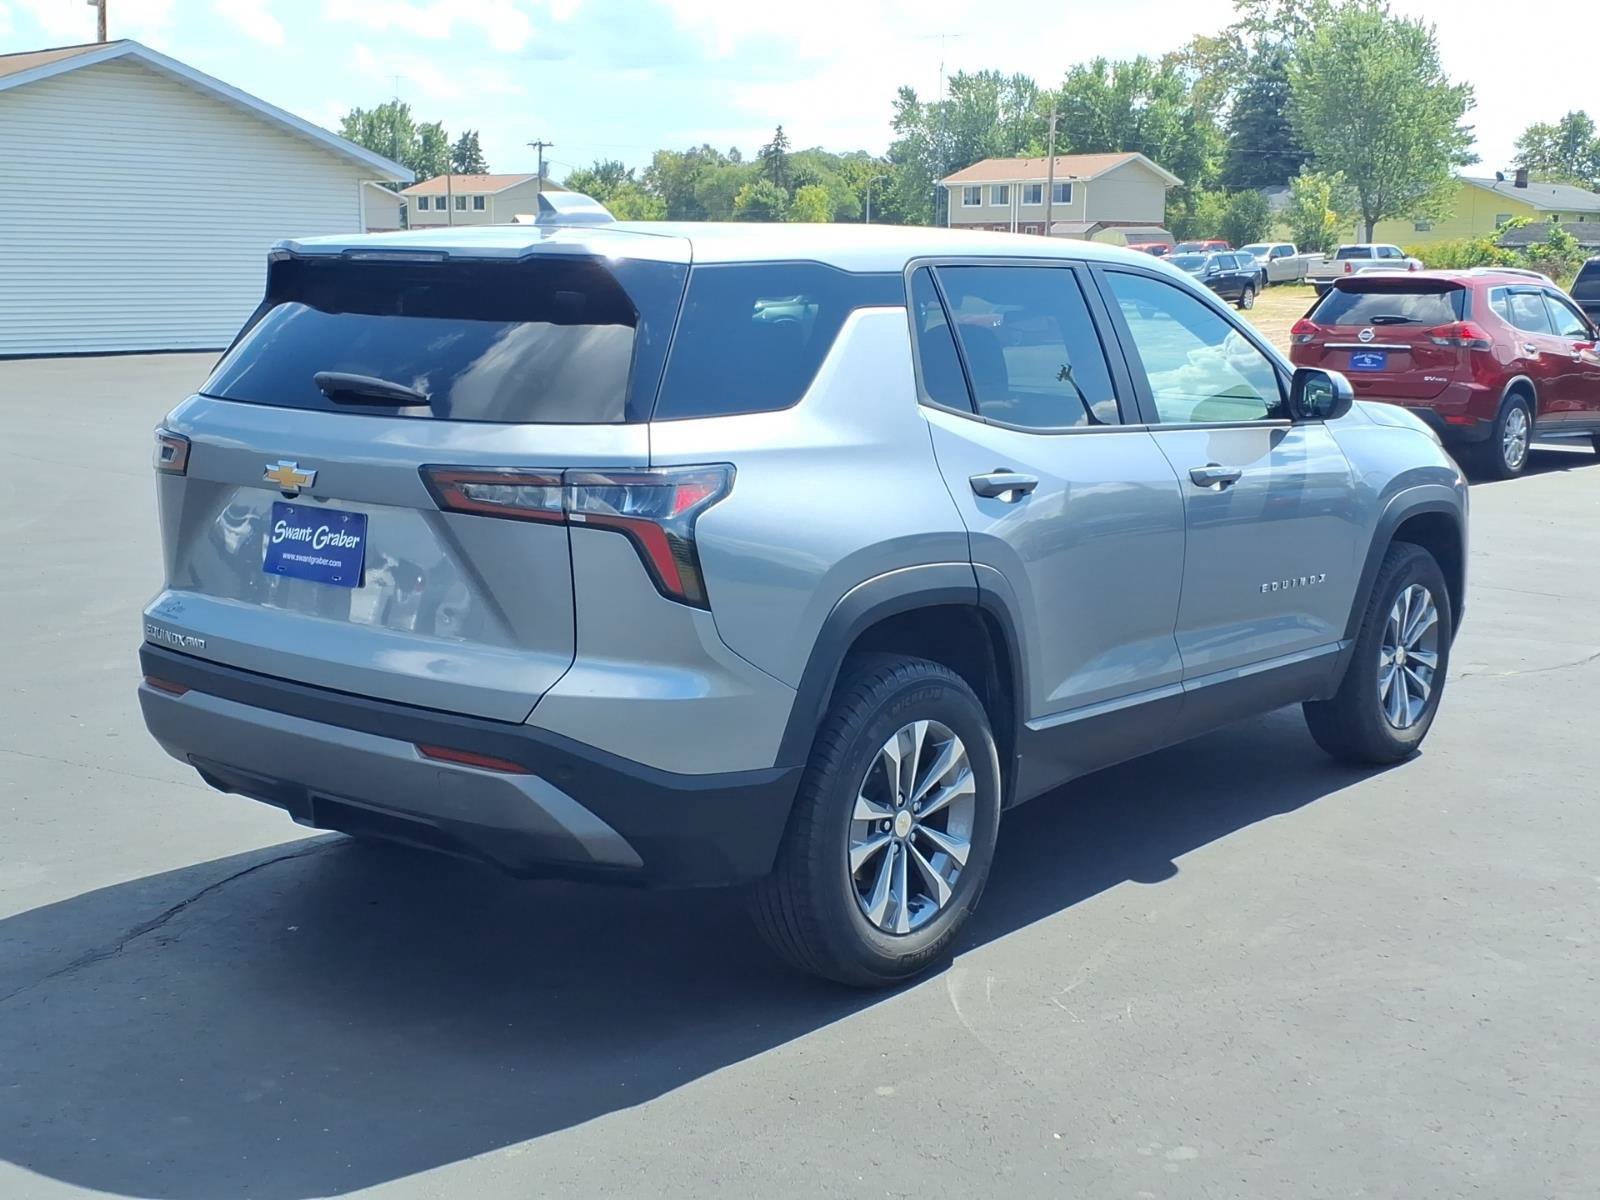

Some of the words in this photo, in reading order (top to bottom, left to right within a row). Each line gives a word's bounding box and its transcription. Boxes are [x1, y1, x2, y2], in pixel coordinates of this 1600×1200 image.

[272, 520, 313, 544] Swant
[312, 525, 360, 550] Graber
[282, 553, 342, 568] www.swantgraber.com
[1261, 573, 1326, 593] EQUINOX
[146, 624, 185, 647] EQUINOX
